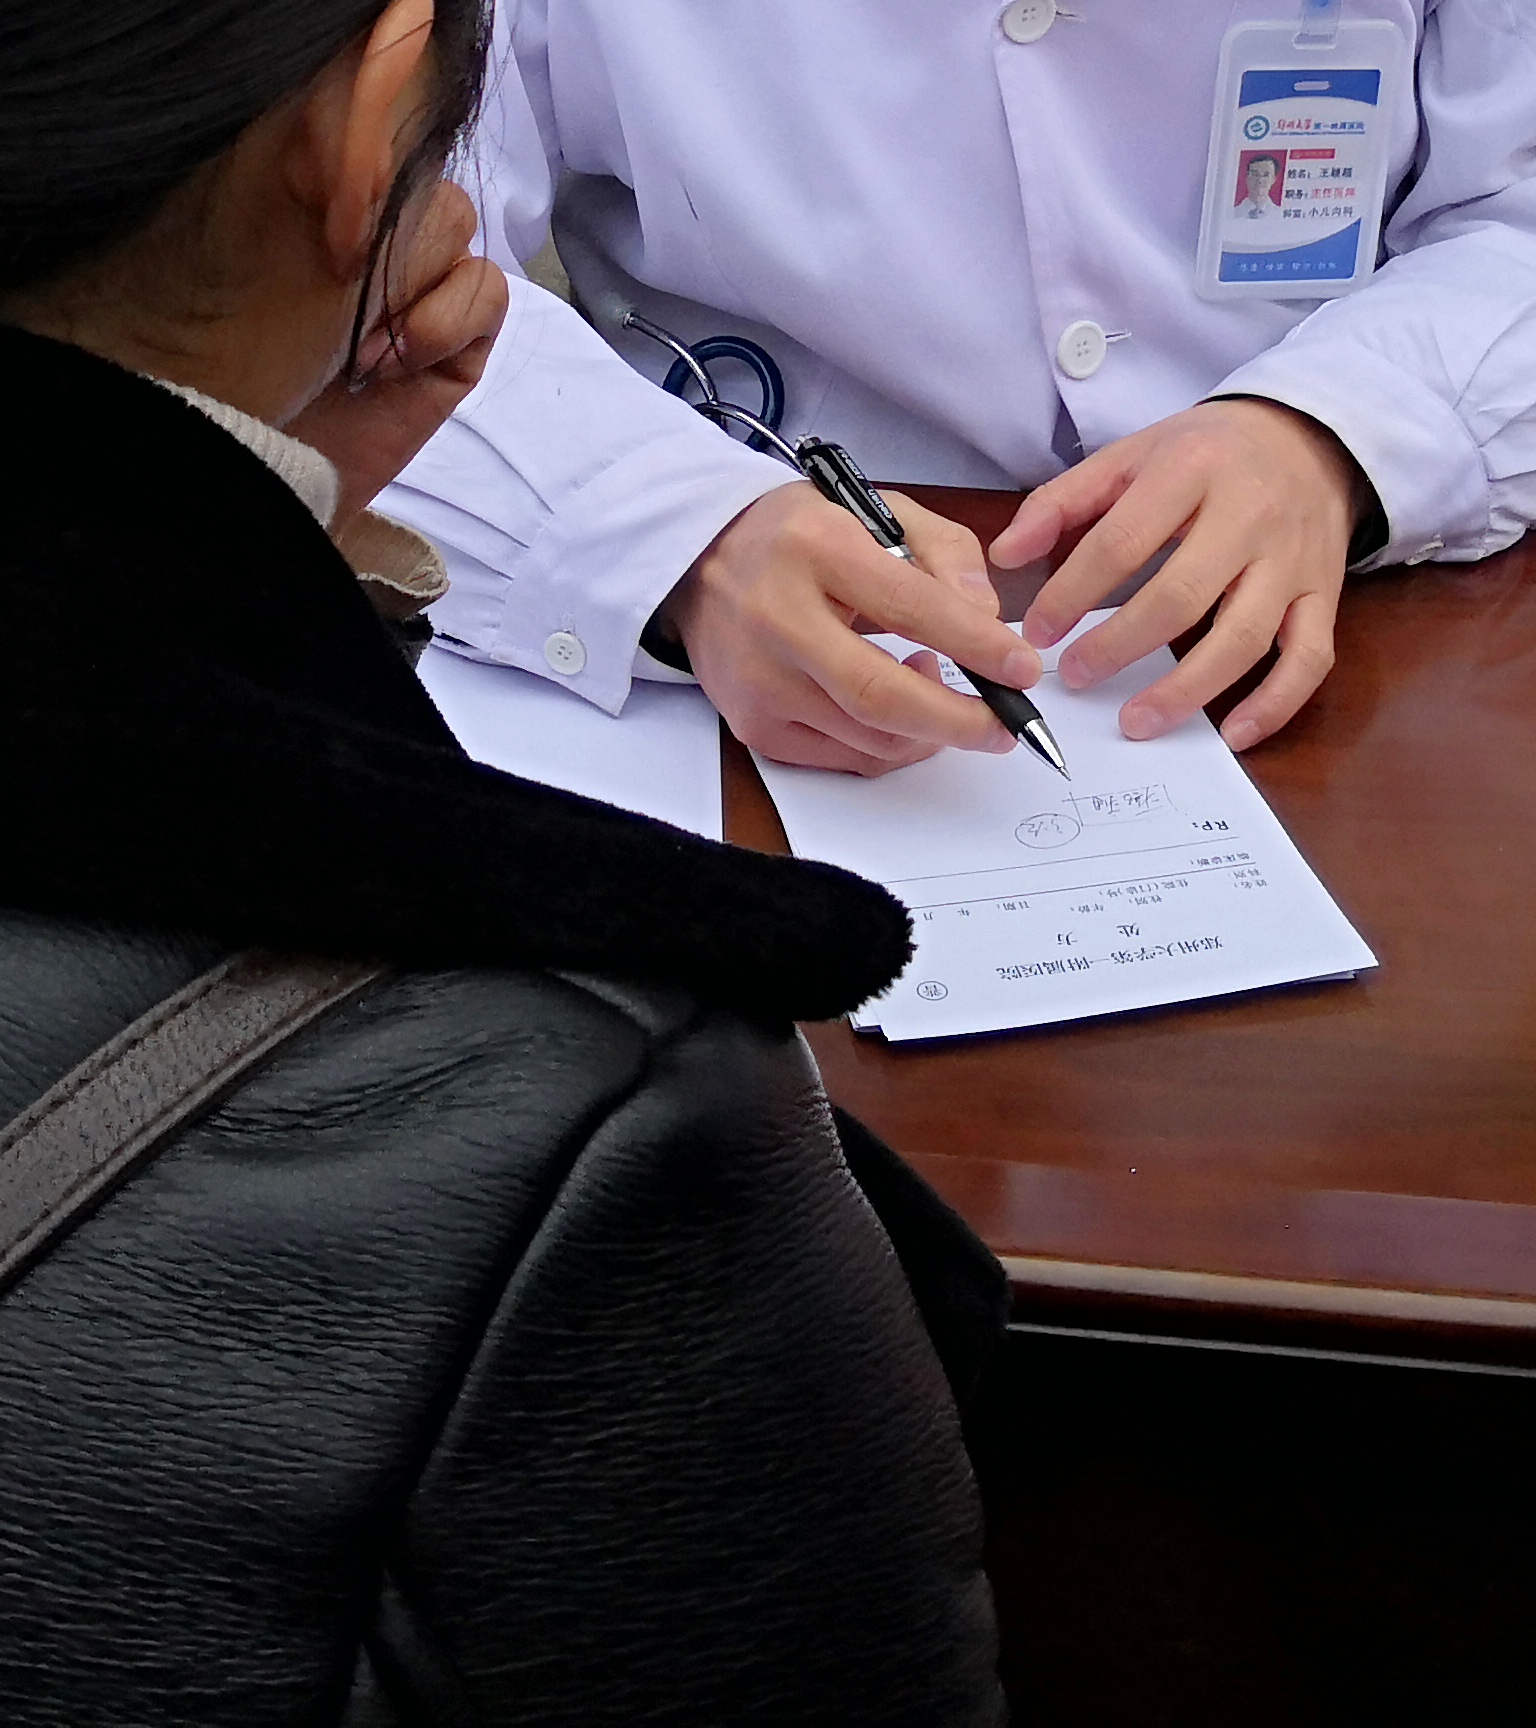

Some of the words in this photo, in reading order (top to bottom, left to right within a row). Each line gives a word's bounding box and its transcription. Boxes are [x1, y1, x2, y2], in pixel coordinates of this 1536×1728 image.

[1308, 206, 1353, 218] 小儿内科
[995, 935, 1224, 981] 郑州大学第一附属医院
